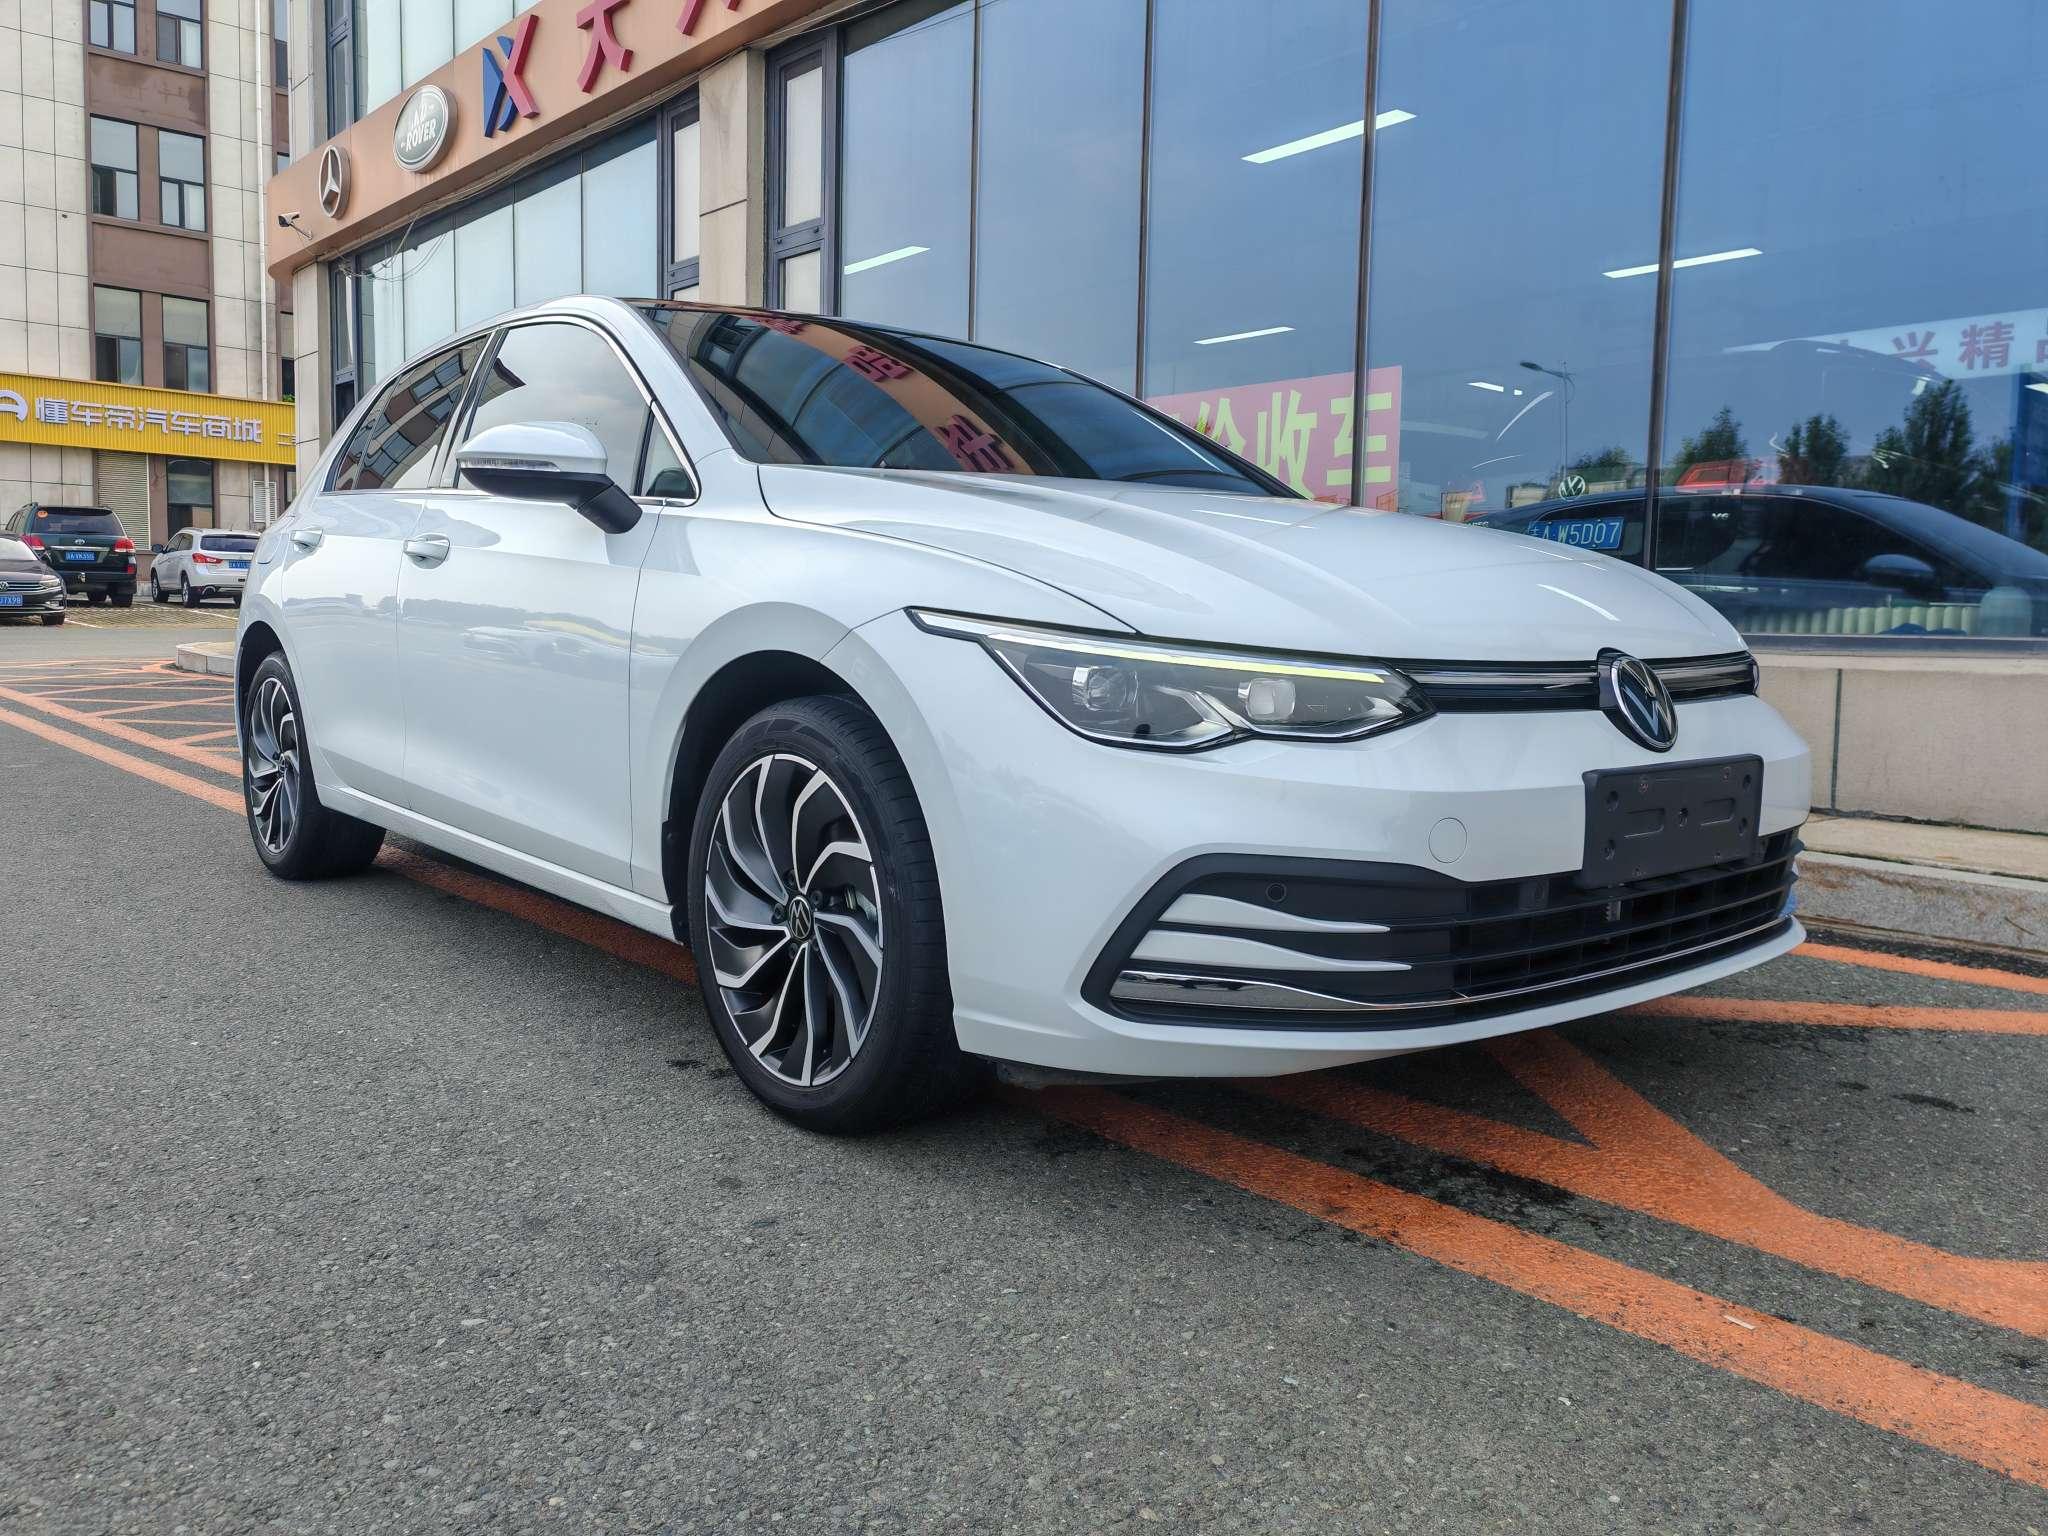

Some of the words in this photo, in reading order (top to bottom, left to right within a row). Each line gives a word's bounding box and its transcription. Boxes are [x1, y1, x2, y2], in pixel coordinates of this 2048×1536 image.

[405, 118, 437, 152] ROVER
[36, 397, 262, 443] 懂车帝汽车商城
